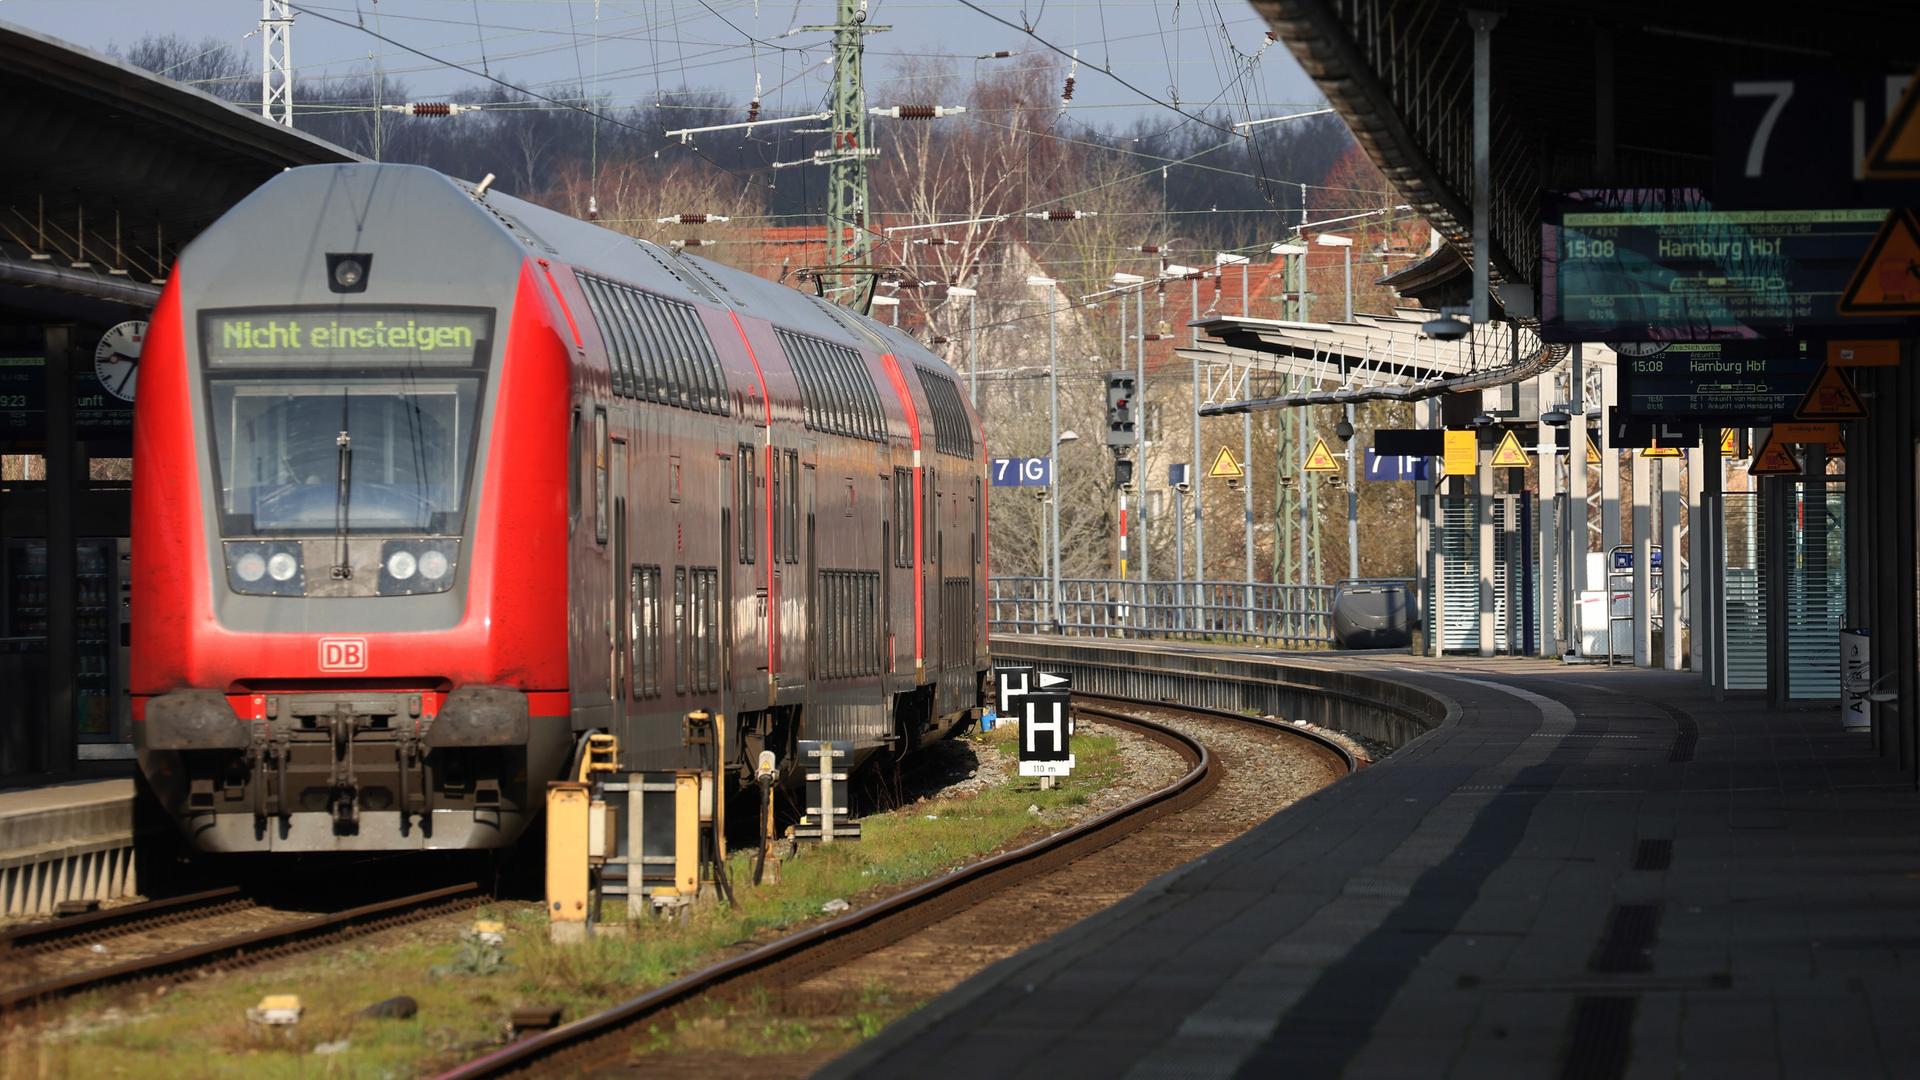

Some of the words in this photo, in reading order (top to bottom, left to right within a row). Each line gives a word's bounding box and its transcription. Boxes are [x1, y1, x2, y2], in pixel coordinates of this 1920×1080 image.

[1732, 79, 1796, 179] 7
[1565, 239, 1615, 259] 15:08
[1658, 237, 1743, 261] Hamburg
[1750, 237, 1782, 256] Hbf
[223, 320, 302, 349] Nicht
[309, 319, 473, 352] einsteigen
[1632, 360, 1664, 373] 15:08
[1690, 360, 1742, 374] Hamburg
[1746, 359, 1768, 372] Hbf
[1747, 395, 1773, 404] Hamburg
[1747, 402, 1773, 411] Hamburg
[995, 459, 1010, 481] 7
[1025, 458, 1043, 480] G
[326, 644, 360, 666] DB
[1026, 702, 1061, 752] H
[1033, 765, 1045, 773] 110
